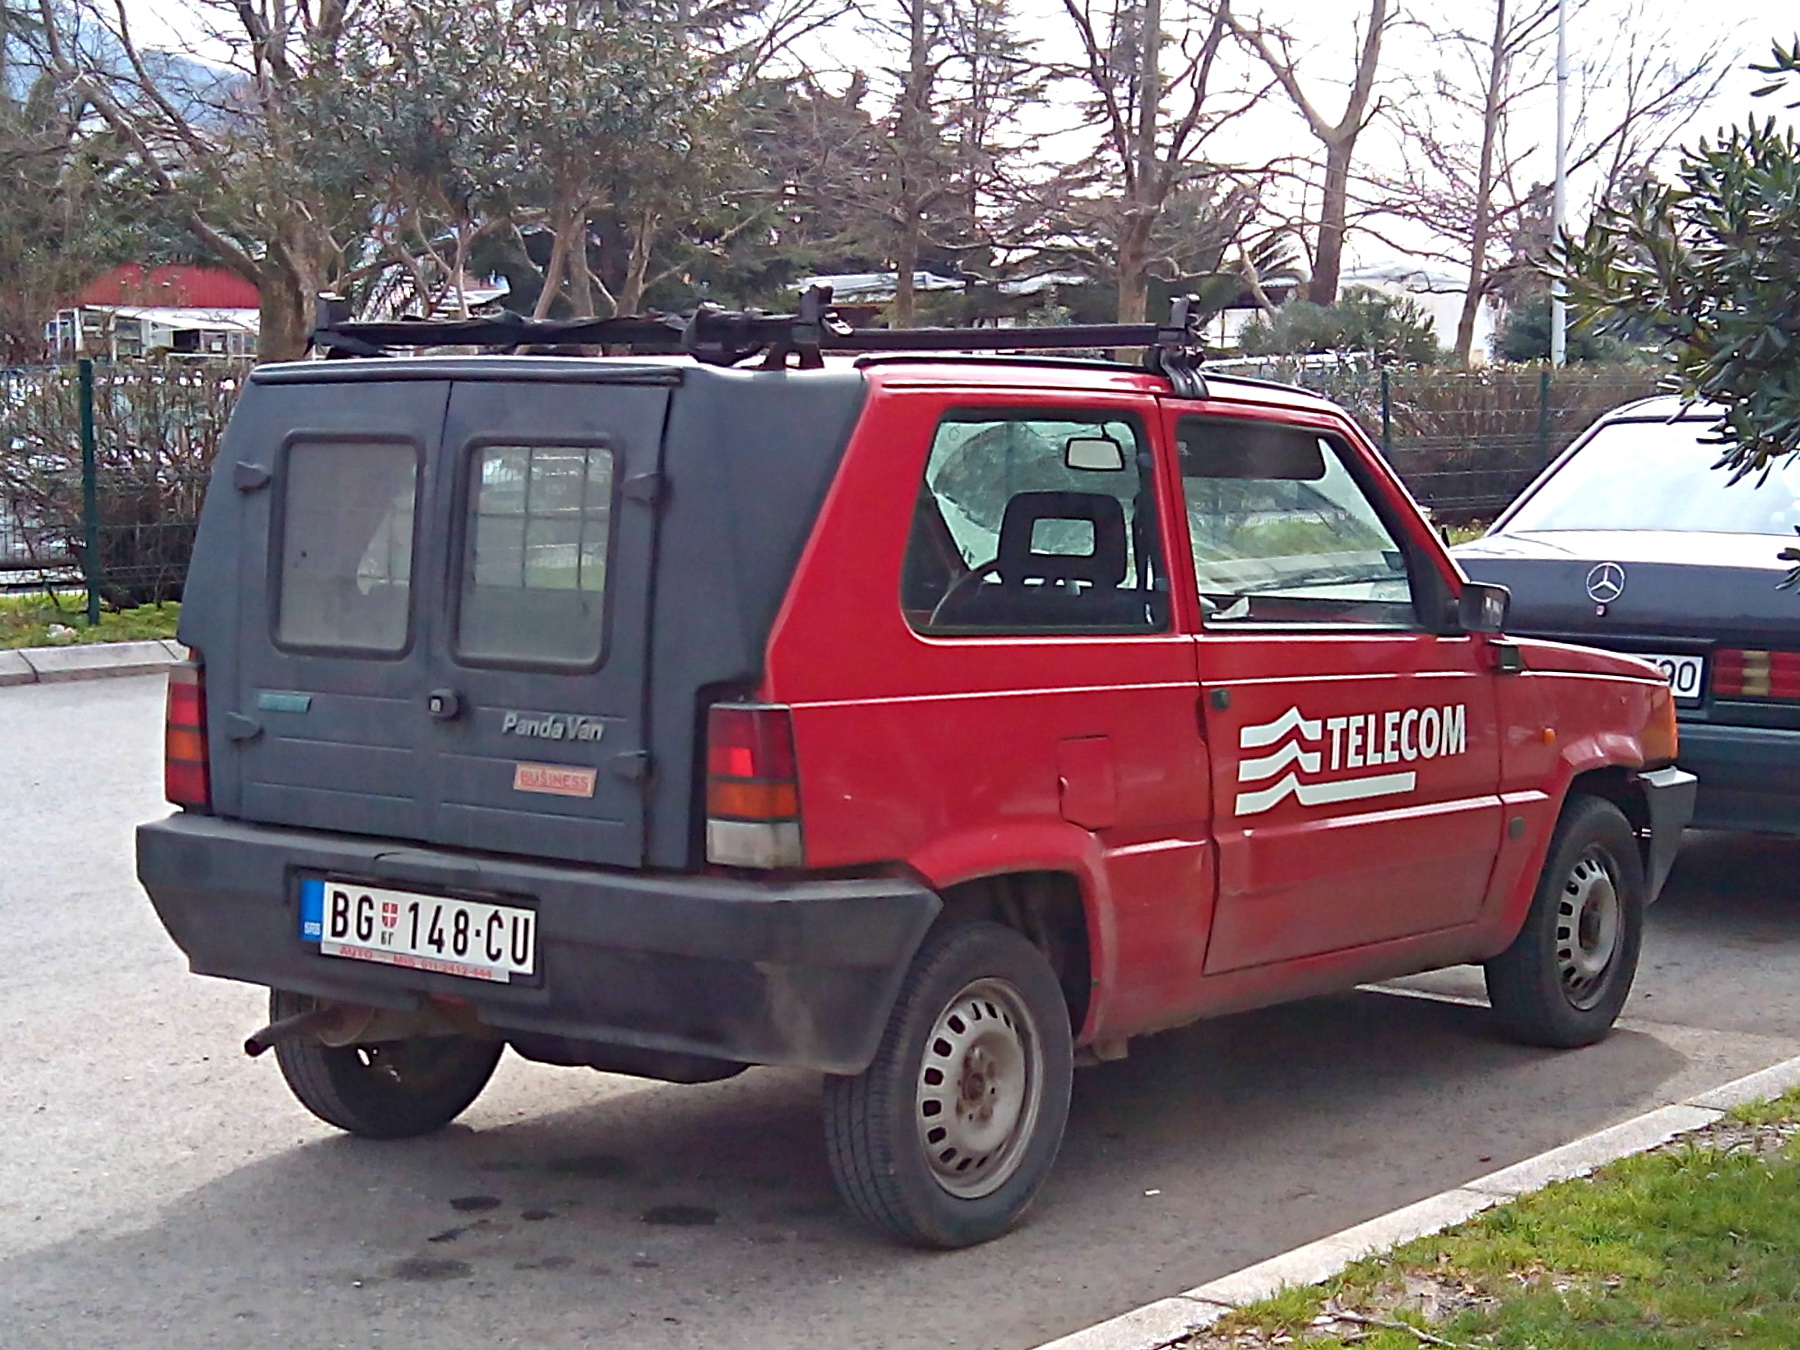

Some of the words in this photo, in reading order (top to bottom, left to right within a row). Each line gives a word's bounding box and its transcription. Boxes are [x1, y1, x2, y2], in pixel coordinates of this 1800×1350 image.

[1643, 657, 1696, 692] 90
[502, 712, 564, 739] Panda
[566, 716, 604, 740] Van
[1327, 704, 1466, 770] TELECOM
[331, 890, 375, 941] BG
